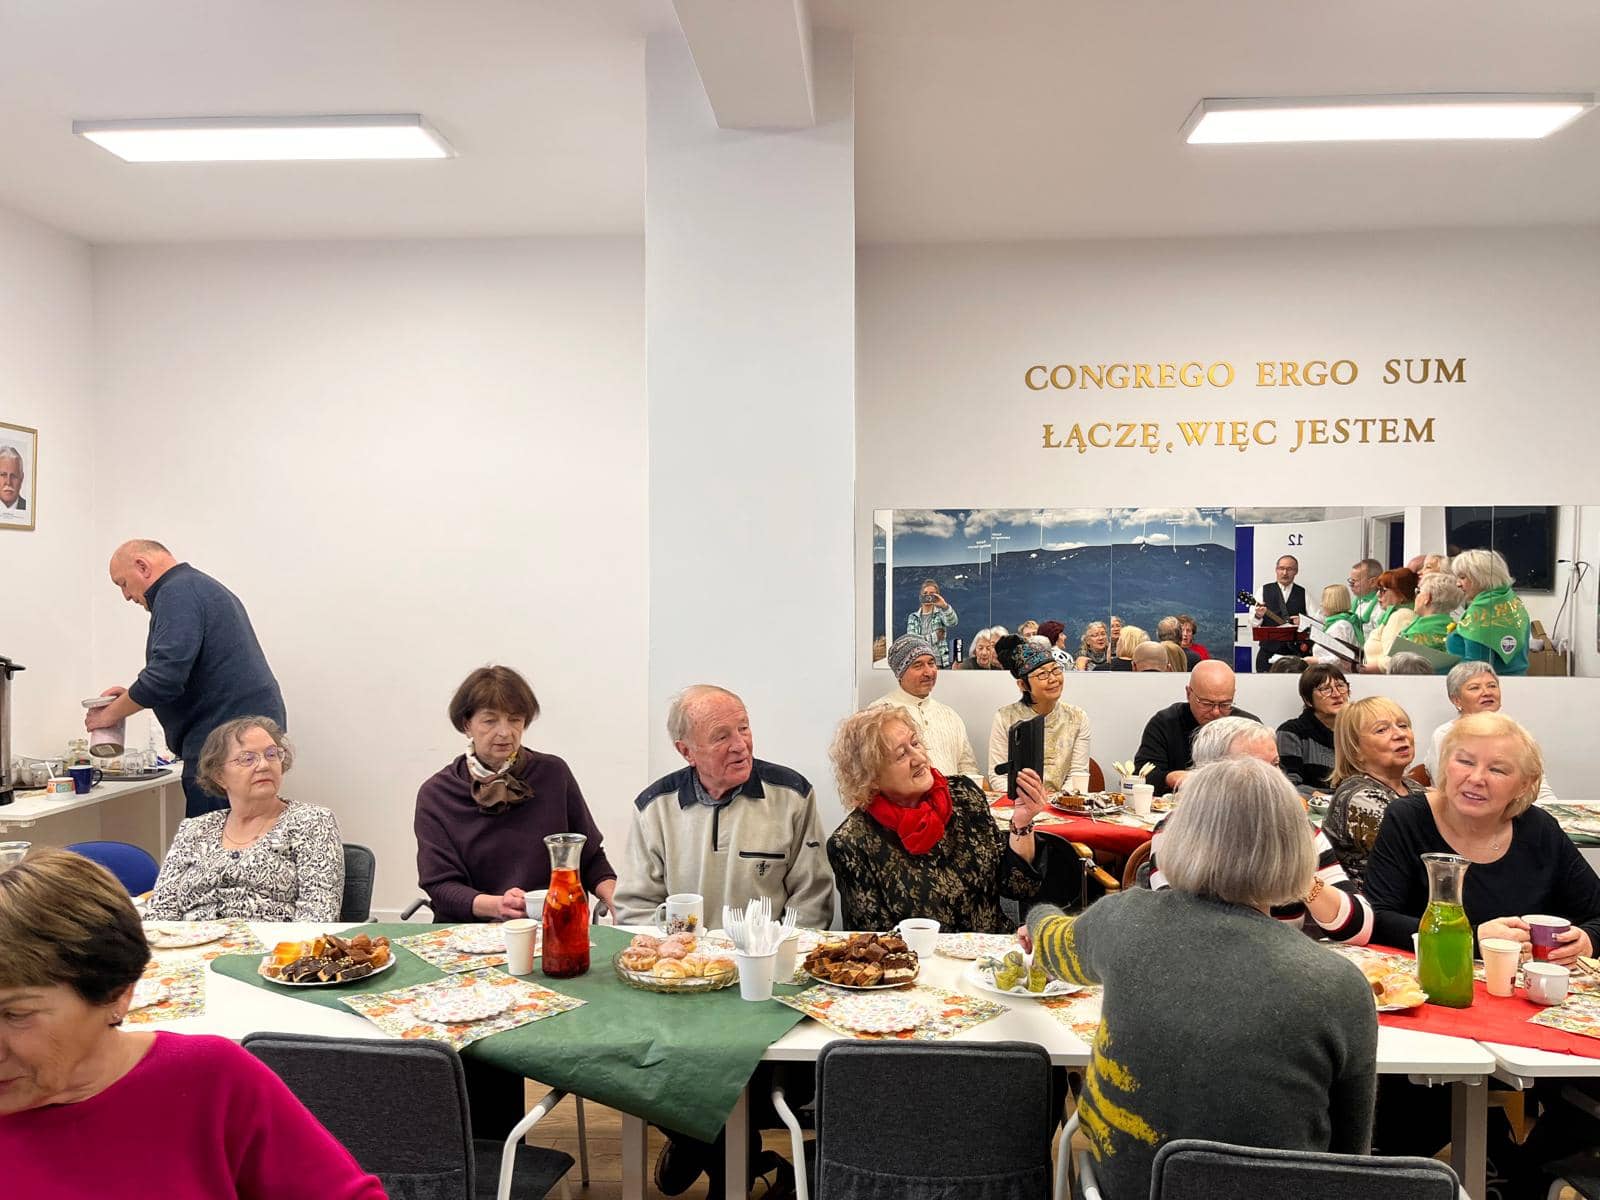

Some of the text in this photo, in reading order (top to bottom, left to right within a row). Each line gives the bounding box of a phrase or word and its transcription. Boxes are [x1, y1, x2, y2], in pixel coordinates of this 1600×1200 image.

[1025, 358, 1467, 391] CONGREGO ERGO SUM
[1042, 417, 1436, 453] ŁĄCZĘ, WIĘC JESTEM
